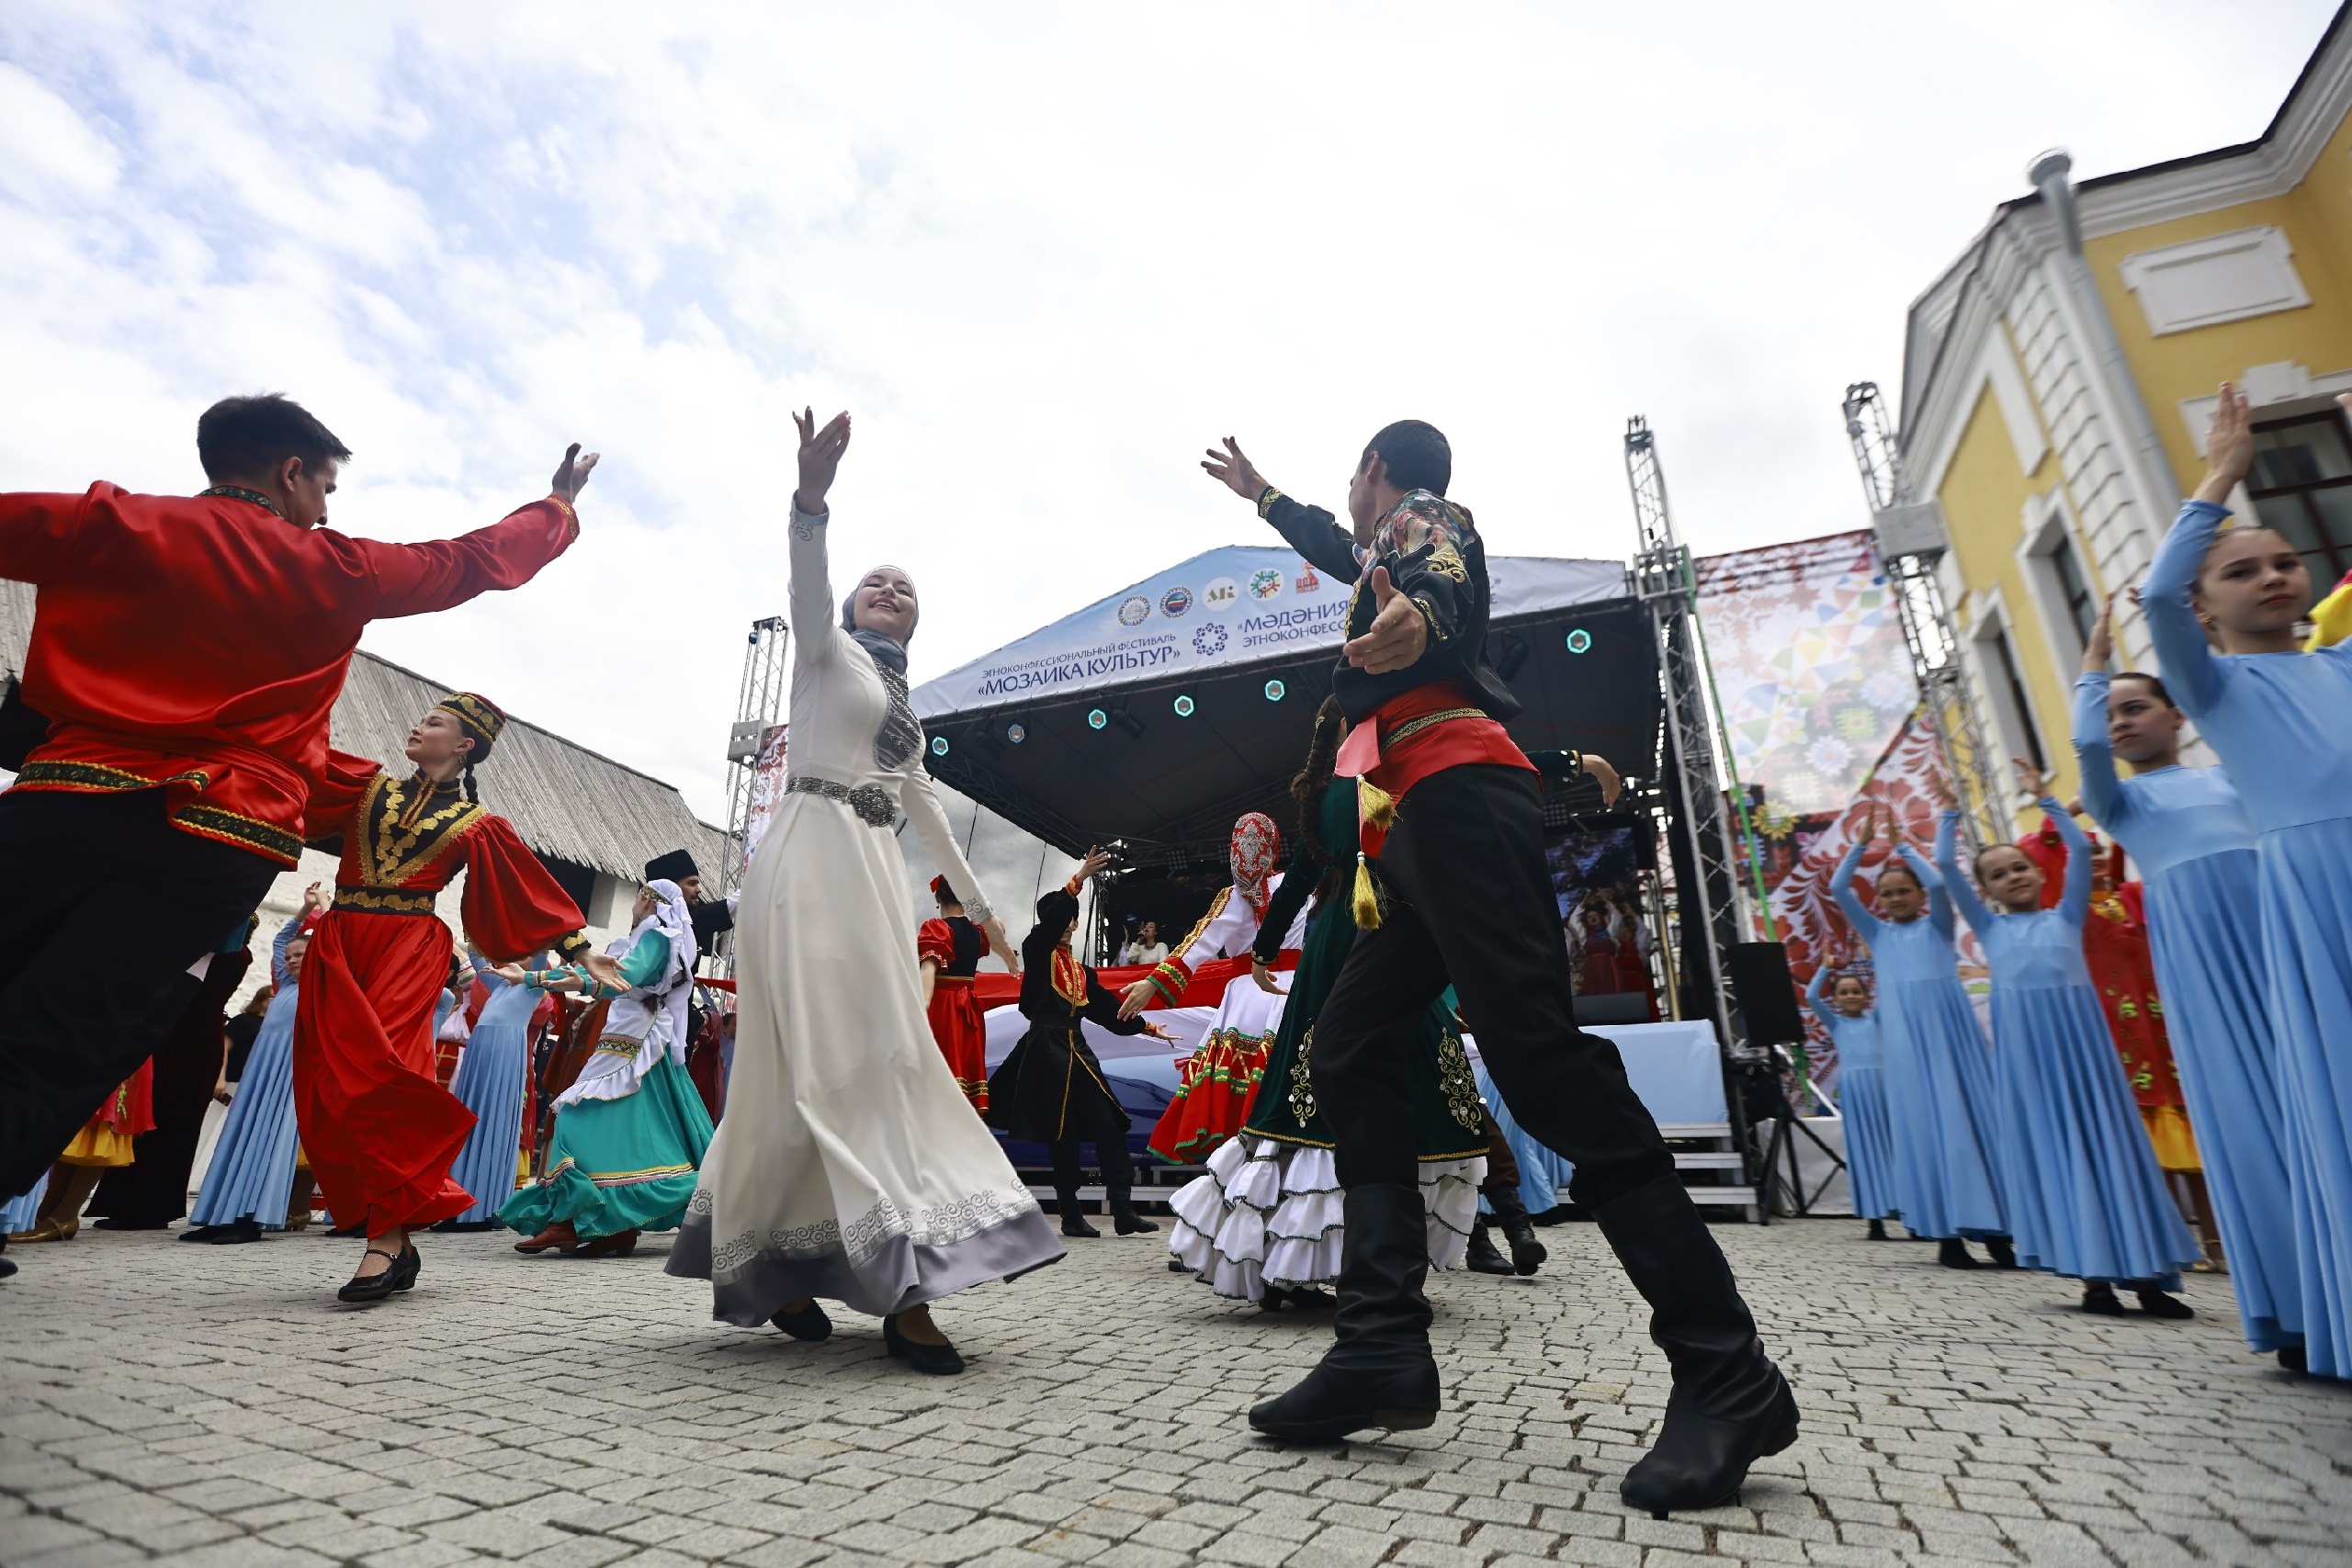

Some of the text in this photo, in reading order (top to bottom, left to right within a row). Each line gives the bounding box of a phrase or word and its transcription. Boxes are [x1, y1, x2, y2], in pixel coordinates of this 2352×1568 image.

[1238, 600, 1348, 633] «МӘДӘНИЯ
[1243, 619, 1345, 647] ЭТНОКОНФЕСС
[978, 646, 1181, 695] «МОЗАИКА КУЛЬТУР»
[982, 634, 1176, 678] ЭТНОКОНФЕССИОНАЛЬНЫЙ ФЕСТИВАЛЬ
